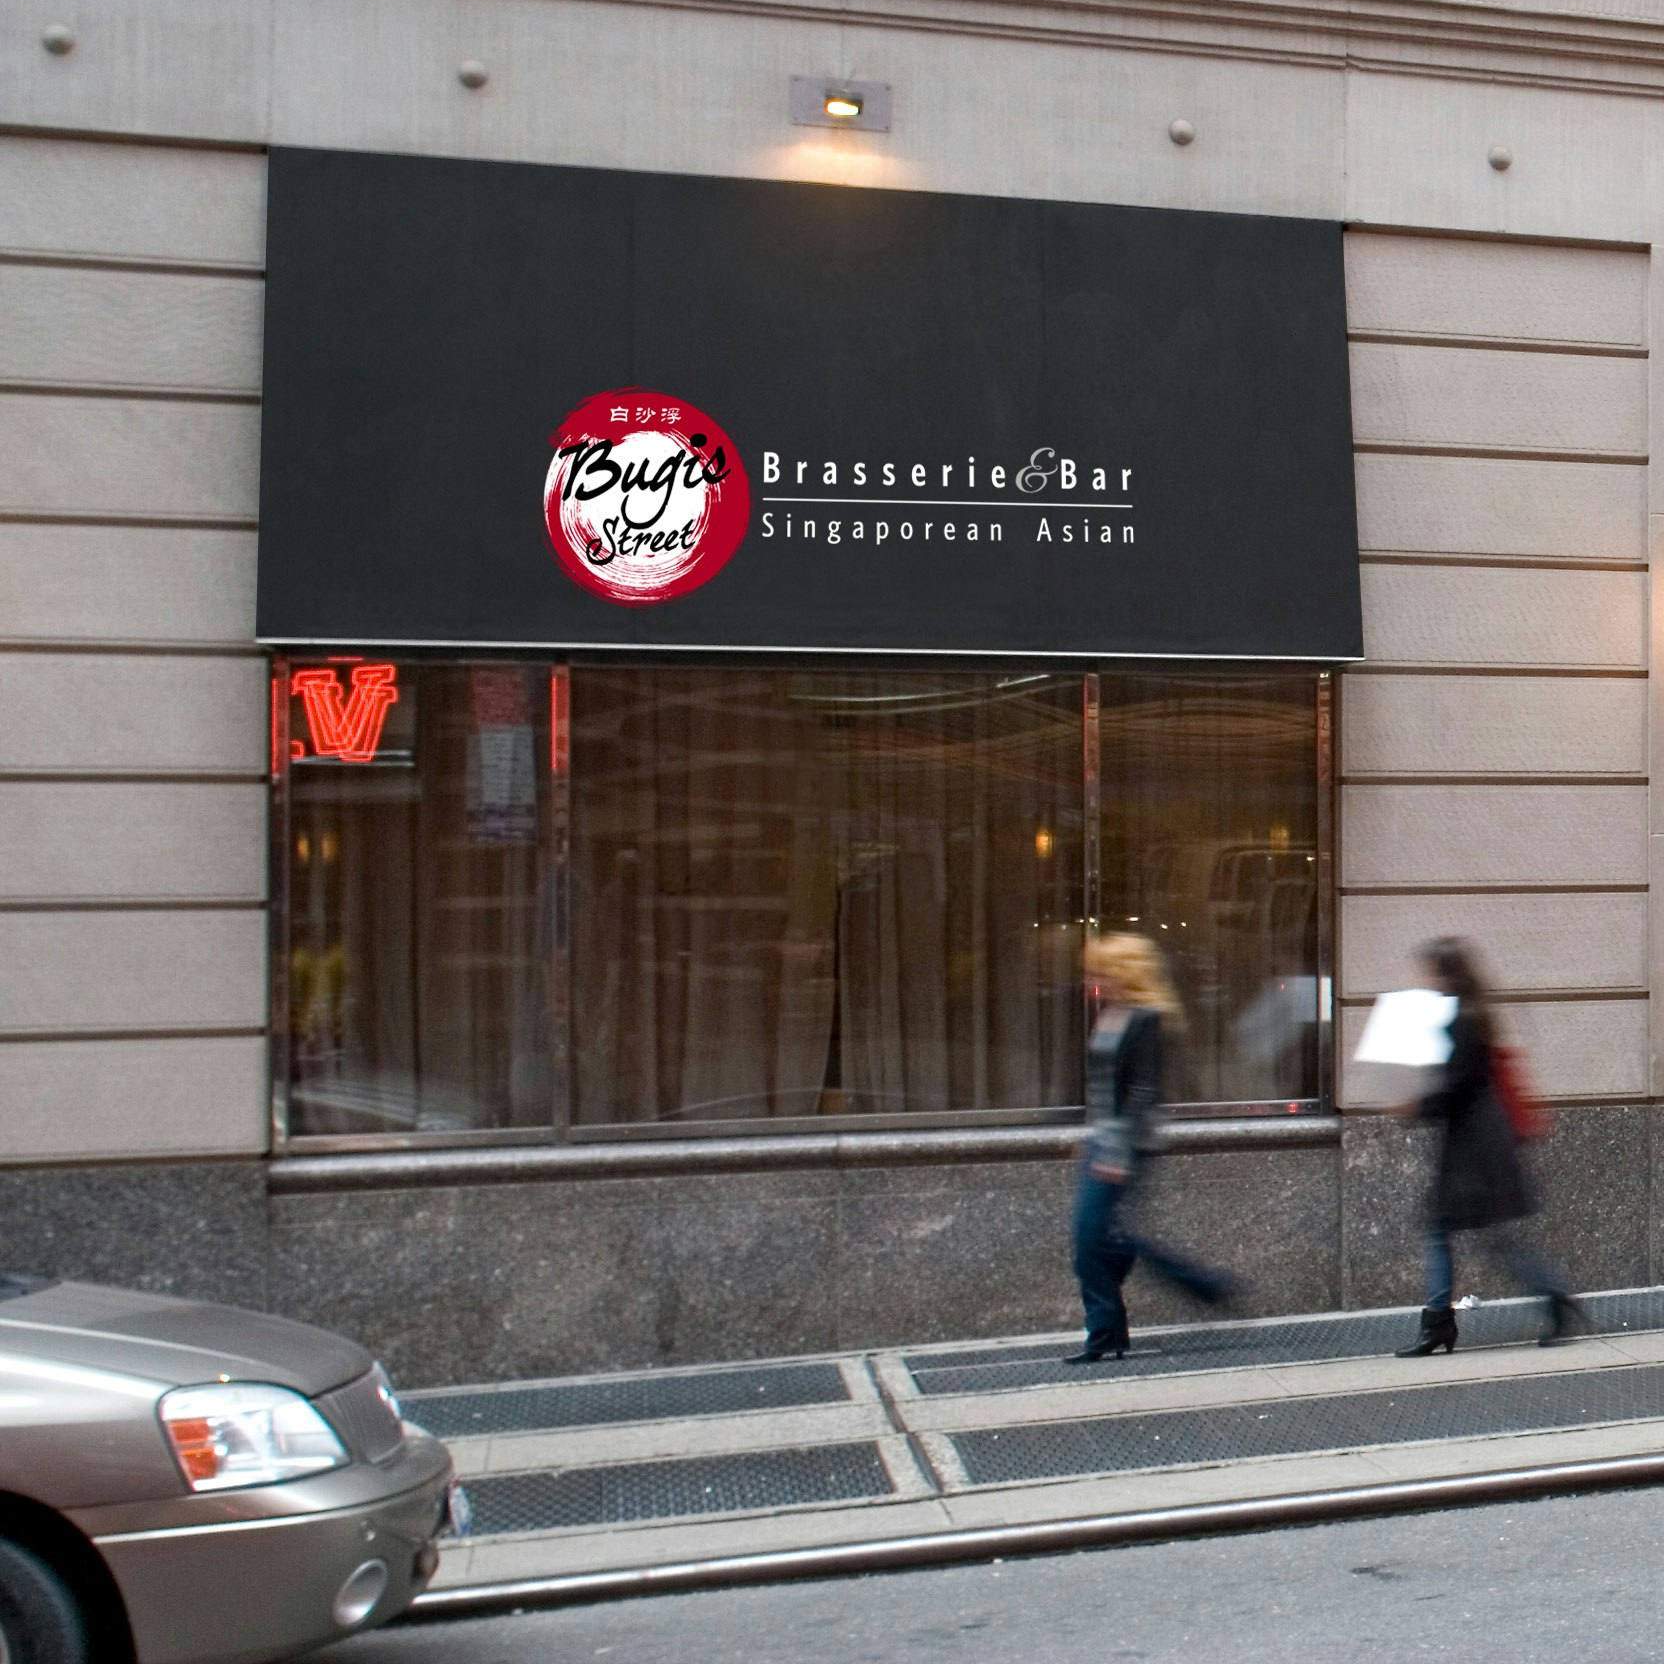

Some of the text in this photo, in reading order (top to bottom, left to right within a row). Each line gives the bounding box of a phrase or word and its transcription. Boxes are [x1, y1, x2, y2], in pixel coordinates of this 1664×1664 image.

[610, 405, 682, 424] 白沙浮
[558, 432, 732, 530] Bugis
[586, 515, 697, 566] Street
[761, 512, 1135, 545] Singaporean Asian
